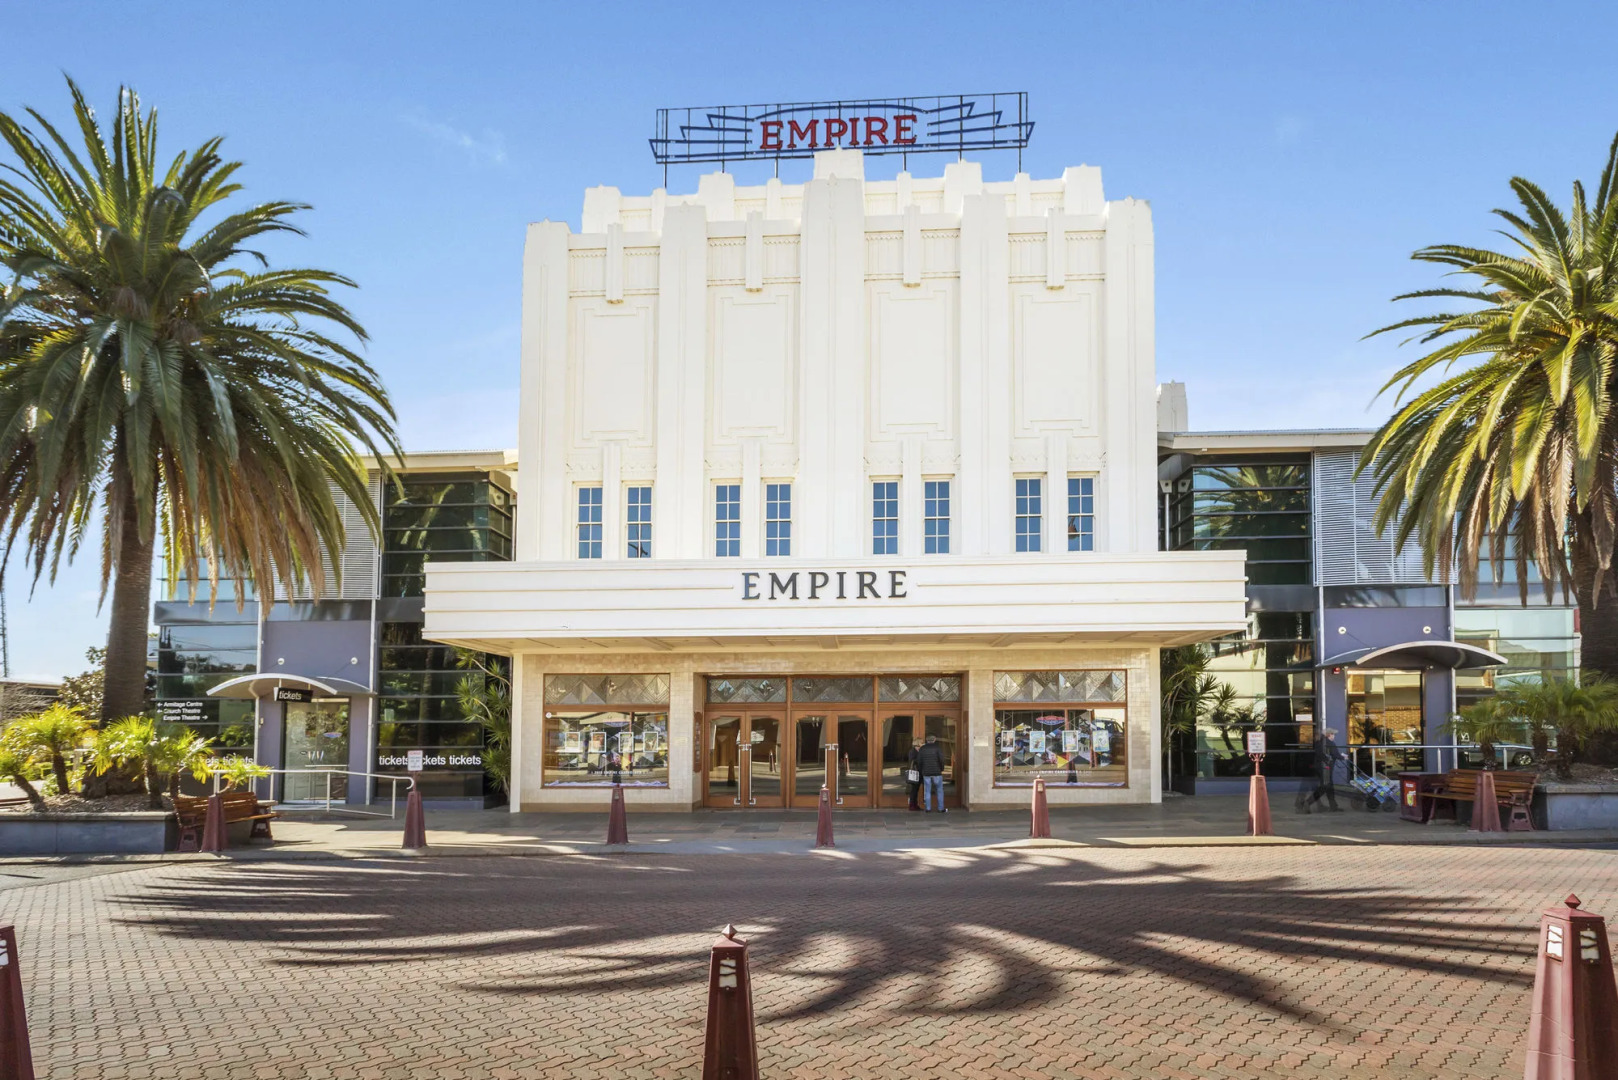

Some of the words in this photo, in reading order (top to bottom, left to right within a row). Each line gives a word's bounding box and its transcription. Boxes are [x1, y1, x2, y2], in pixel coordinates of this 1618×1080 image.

[760, 114, 918, 149] EMPIRE
[741, 570, 908, 600] EMPIRE
[278, 690, 302, 700] tickets
[422, 755, 446, 766] ckets
[448, 754, 482, 765] tickets
